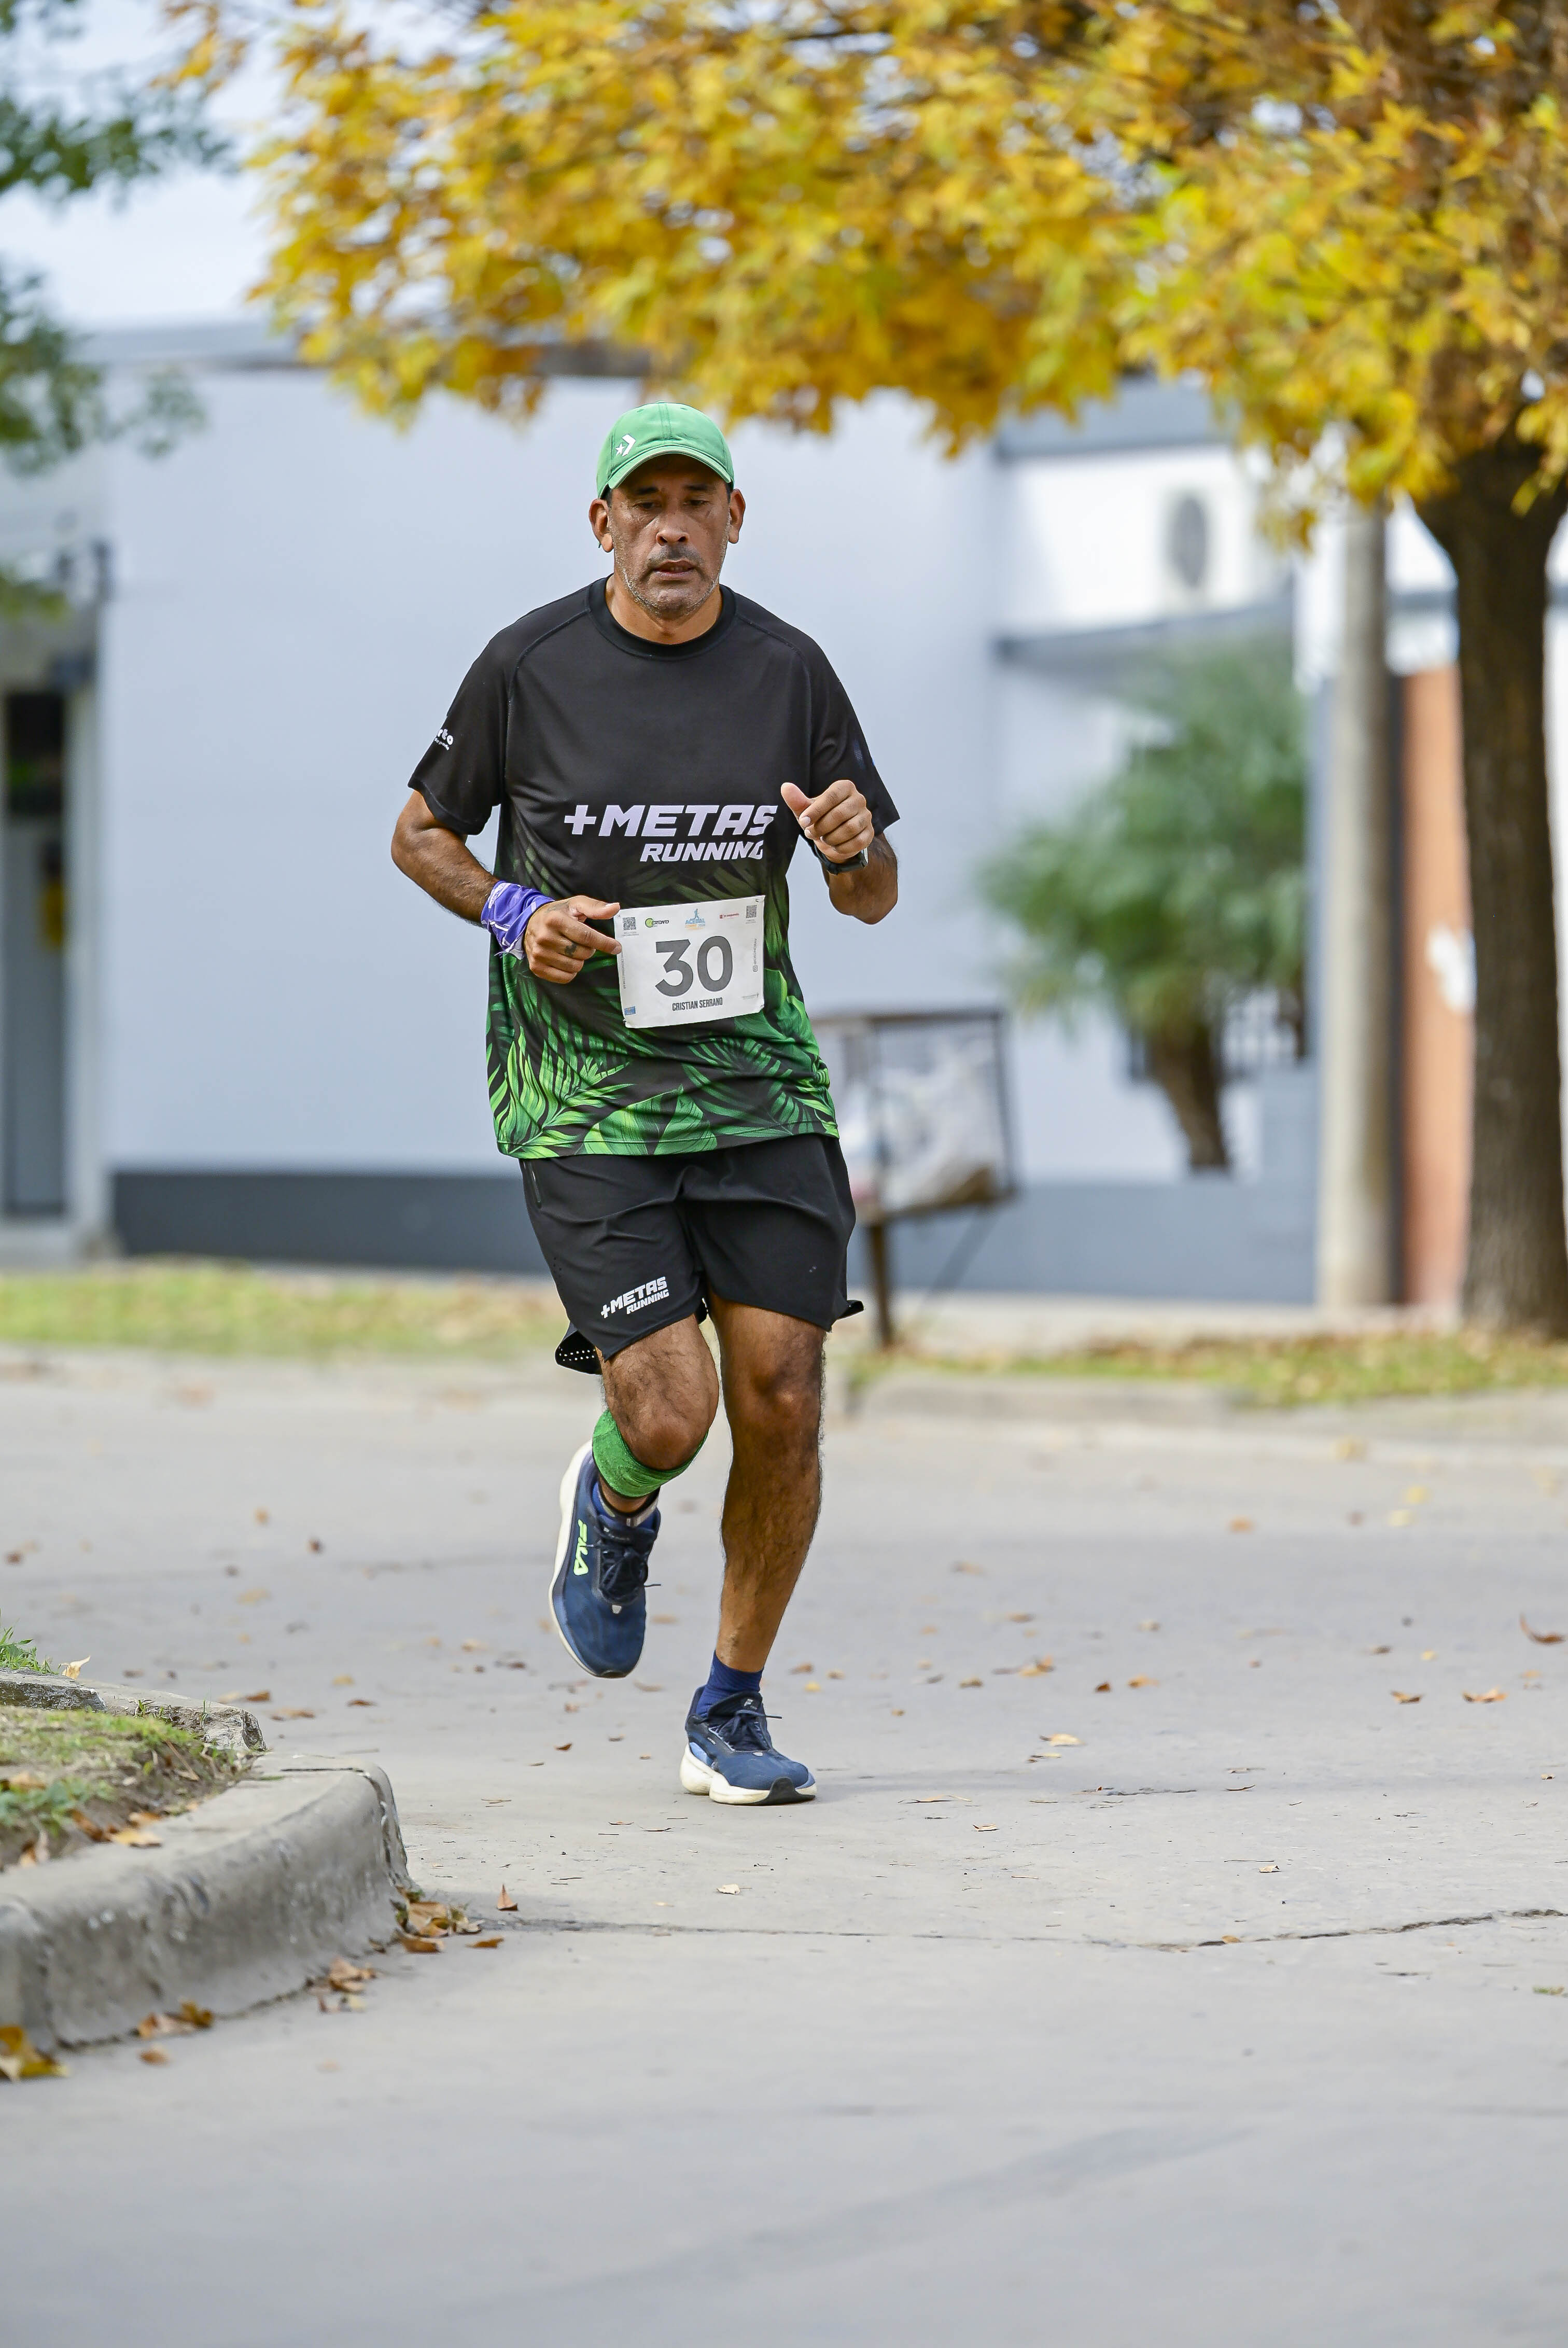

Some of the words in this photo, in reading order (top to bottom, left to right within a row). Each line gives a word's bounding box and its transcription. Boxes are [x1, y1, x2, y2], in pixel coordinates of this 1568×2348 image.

[564, 805, 778, 836] +METAS
[640, 840, 764, 862] RUNNING
[655, 935, 733, 997] 30
[672, 1001, 698, 1011] CRISTIAN
[699, 997, 723, 1008] SERRANO
[600, 1276, 668, 1319] +METAS
[626, 1289, 669, 1315] RUNNING
